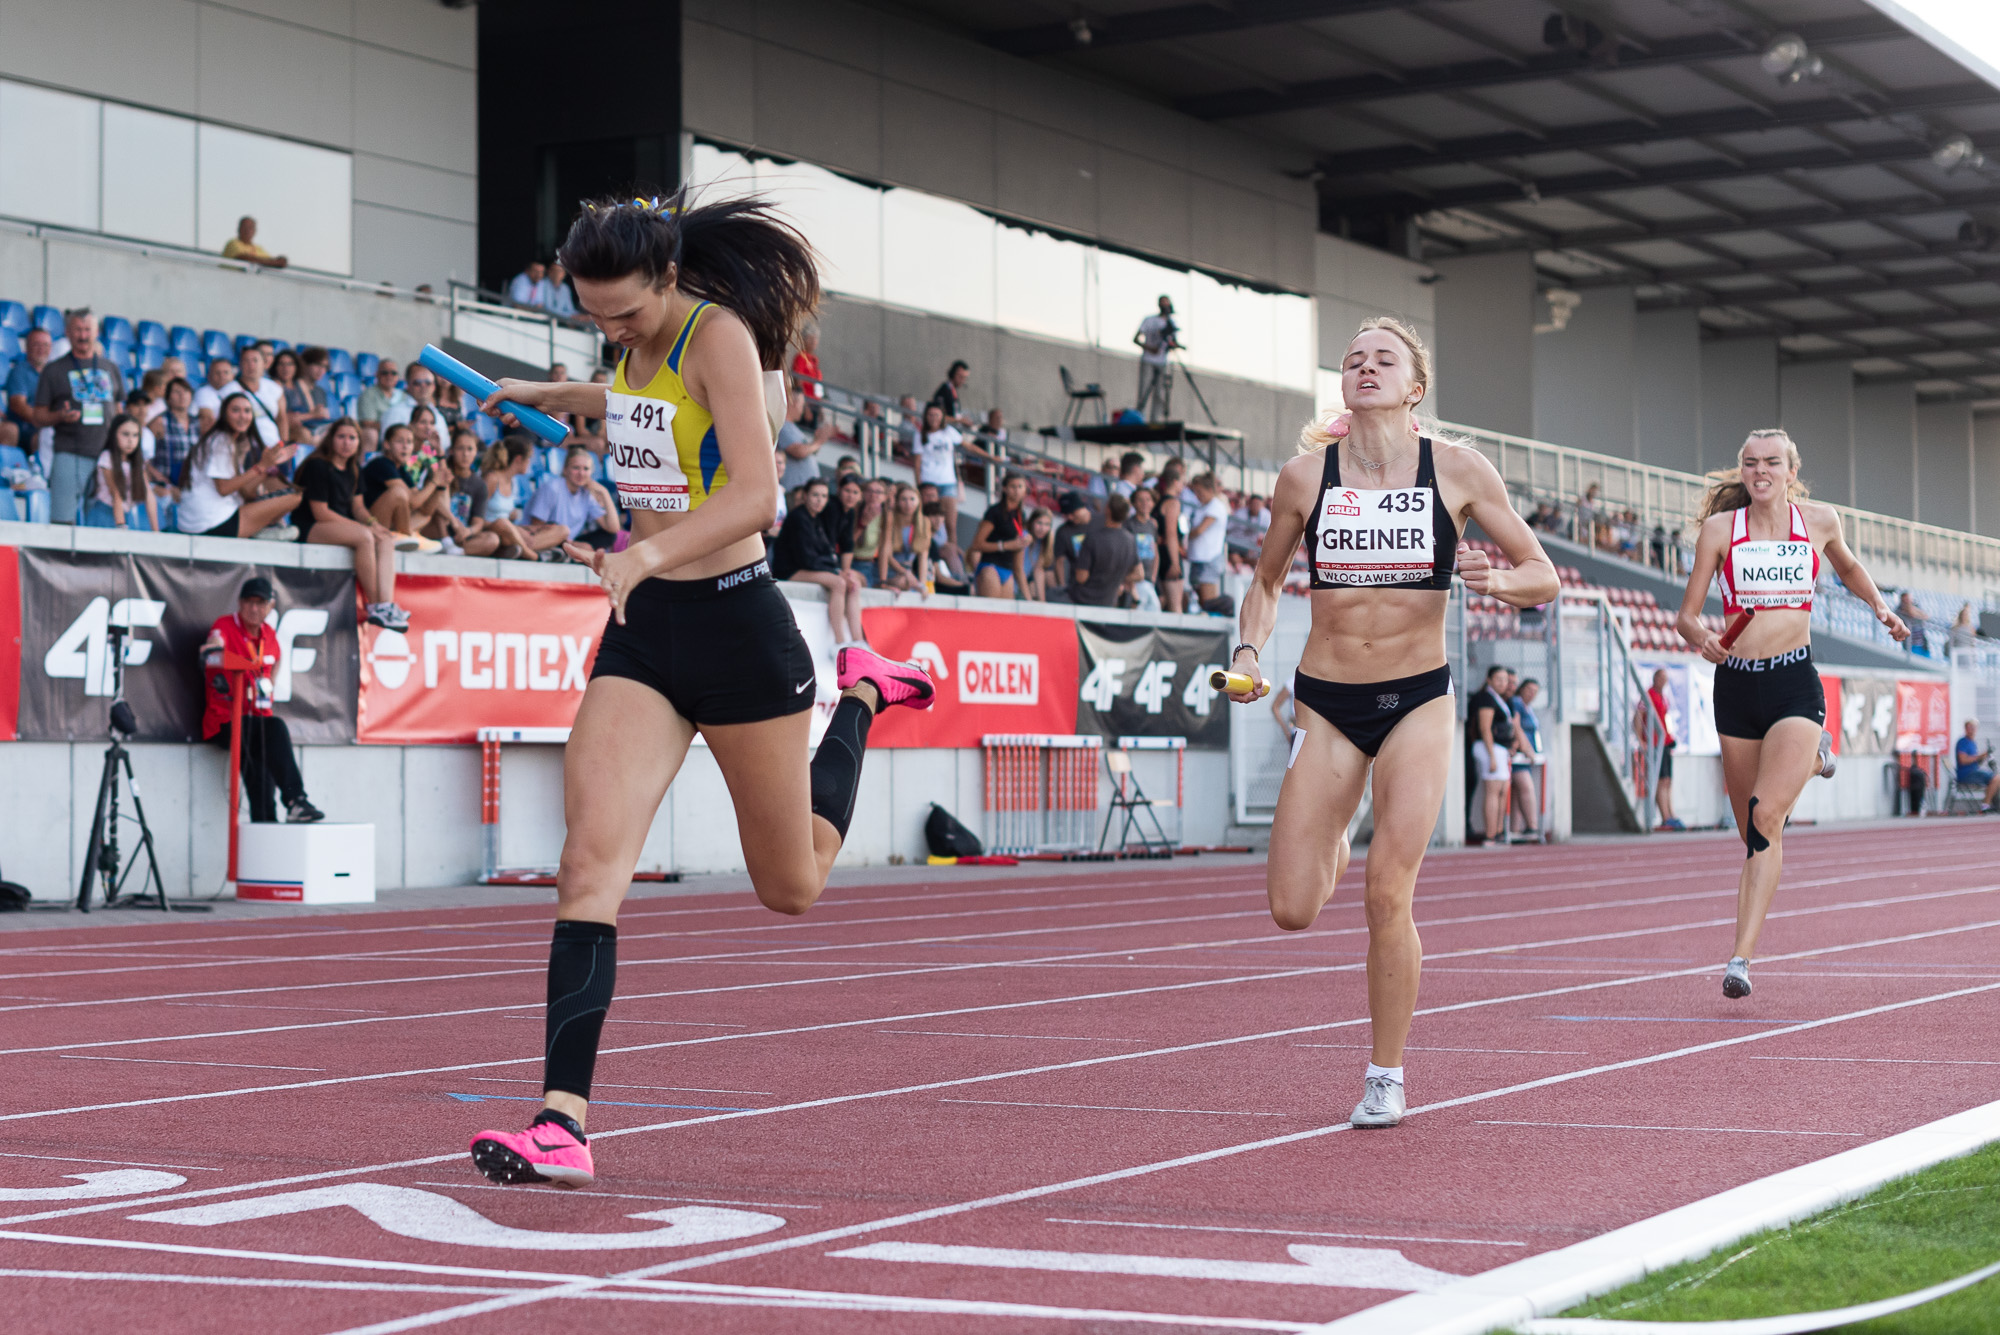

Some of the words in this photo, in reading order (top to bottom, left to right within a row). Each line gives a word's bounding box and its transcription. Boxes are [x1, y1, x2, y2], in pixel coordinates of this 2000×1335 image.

[630, 402, 665, 432] 491
[656, 497, 682, 510] 2021
[1328, 506, 1359, 515] ORLEN
[1378, 491, 1425, 513] 435
[1322, 528, 1426, 550] GREINER
[1777, 544, 1808, 557] 393
[717, 568, 753, 591] NIKE
[1323, 571, 1398, 584] WŁOCŁAWEK
[1742, 563, 1804, 584] NAGIĘĆ
[44, 596, 166, 697] 4F
[1723, 655, 1765, 672] NIKE
[1770, 645, 1808, 670] PRO
[965, 660, 1032, 695] ORLEN
[1081, 658, 1127, 712] 4F
[1134, 660, 1177, 714] 4F
[125, 1182, 787, 1251] 2
